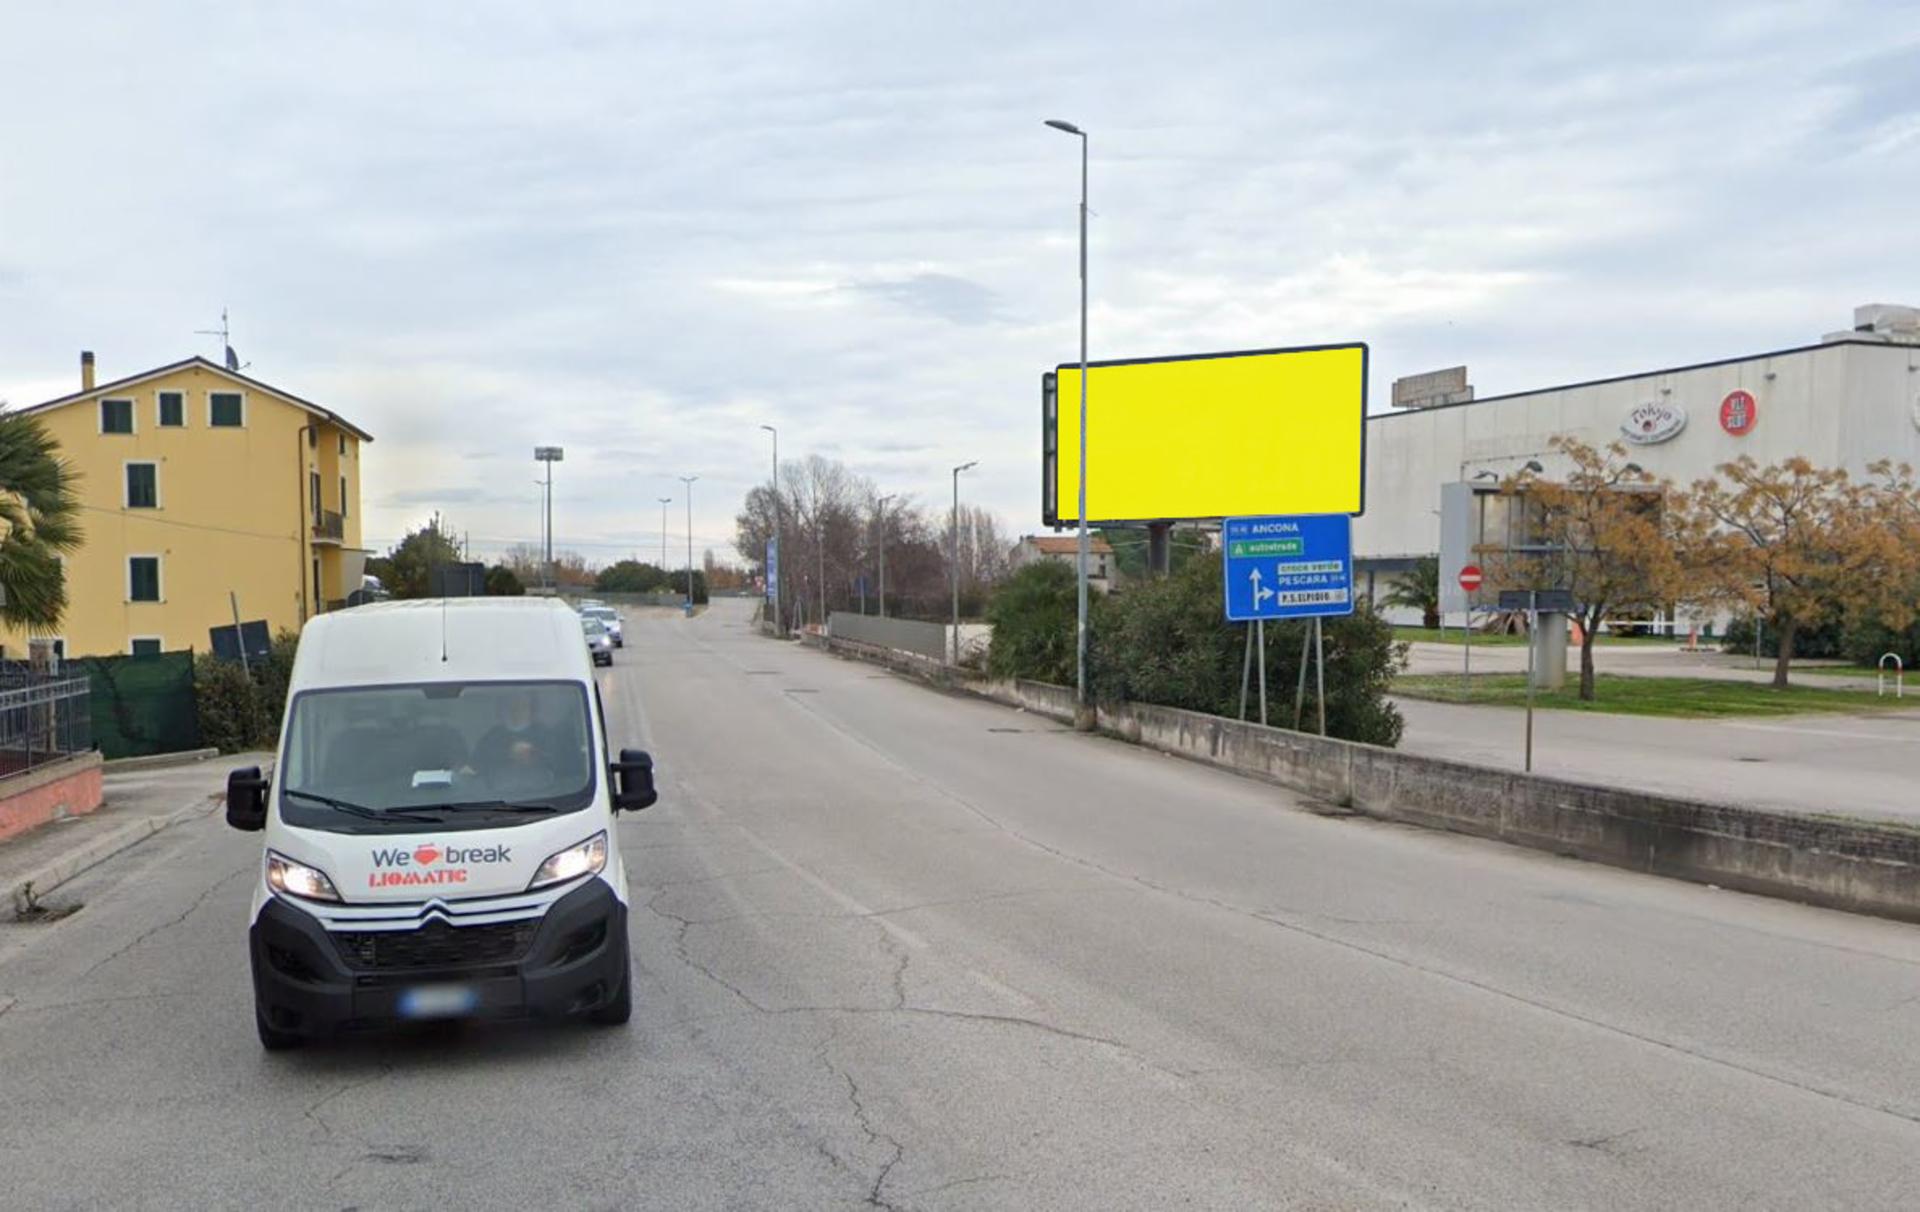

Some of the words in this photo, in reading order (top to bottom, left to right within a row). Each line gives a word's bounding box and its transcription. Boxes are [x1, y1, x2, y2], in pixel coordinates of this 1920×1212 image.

[1631, 402, 1673, 424] Tokyo
[1252, 523, 1299, 534] ANCONA
[1279, 574, 1328, 585] PESCARA
[372, 848, 410, 867] We
[445, 845, 511, 864] break
[369, 869, 467, 888] LIOMATIC
